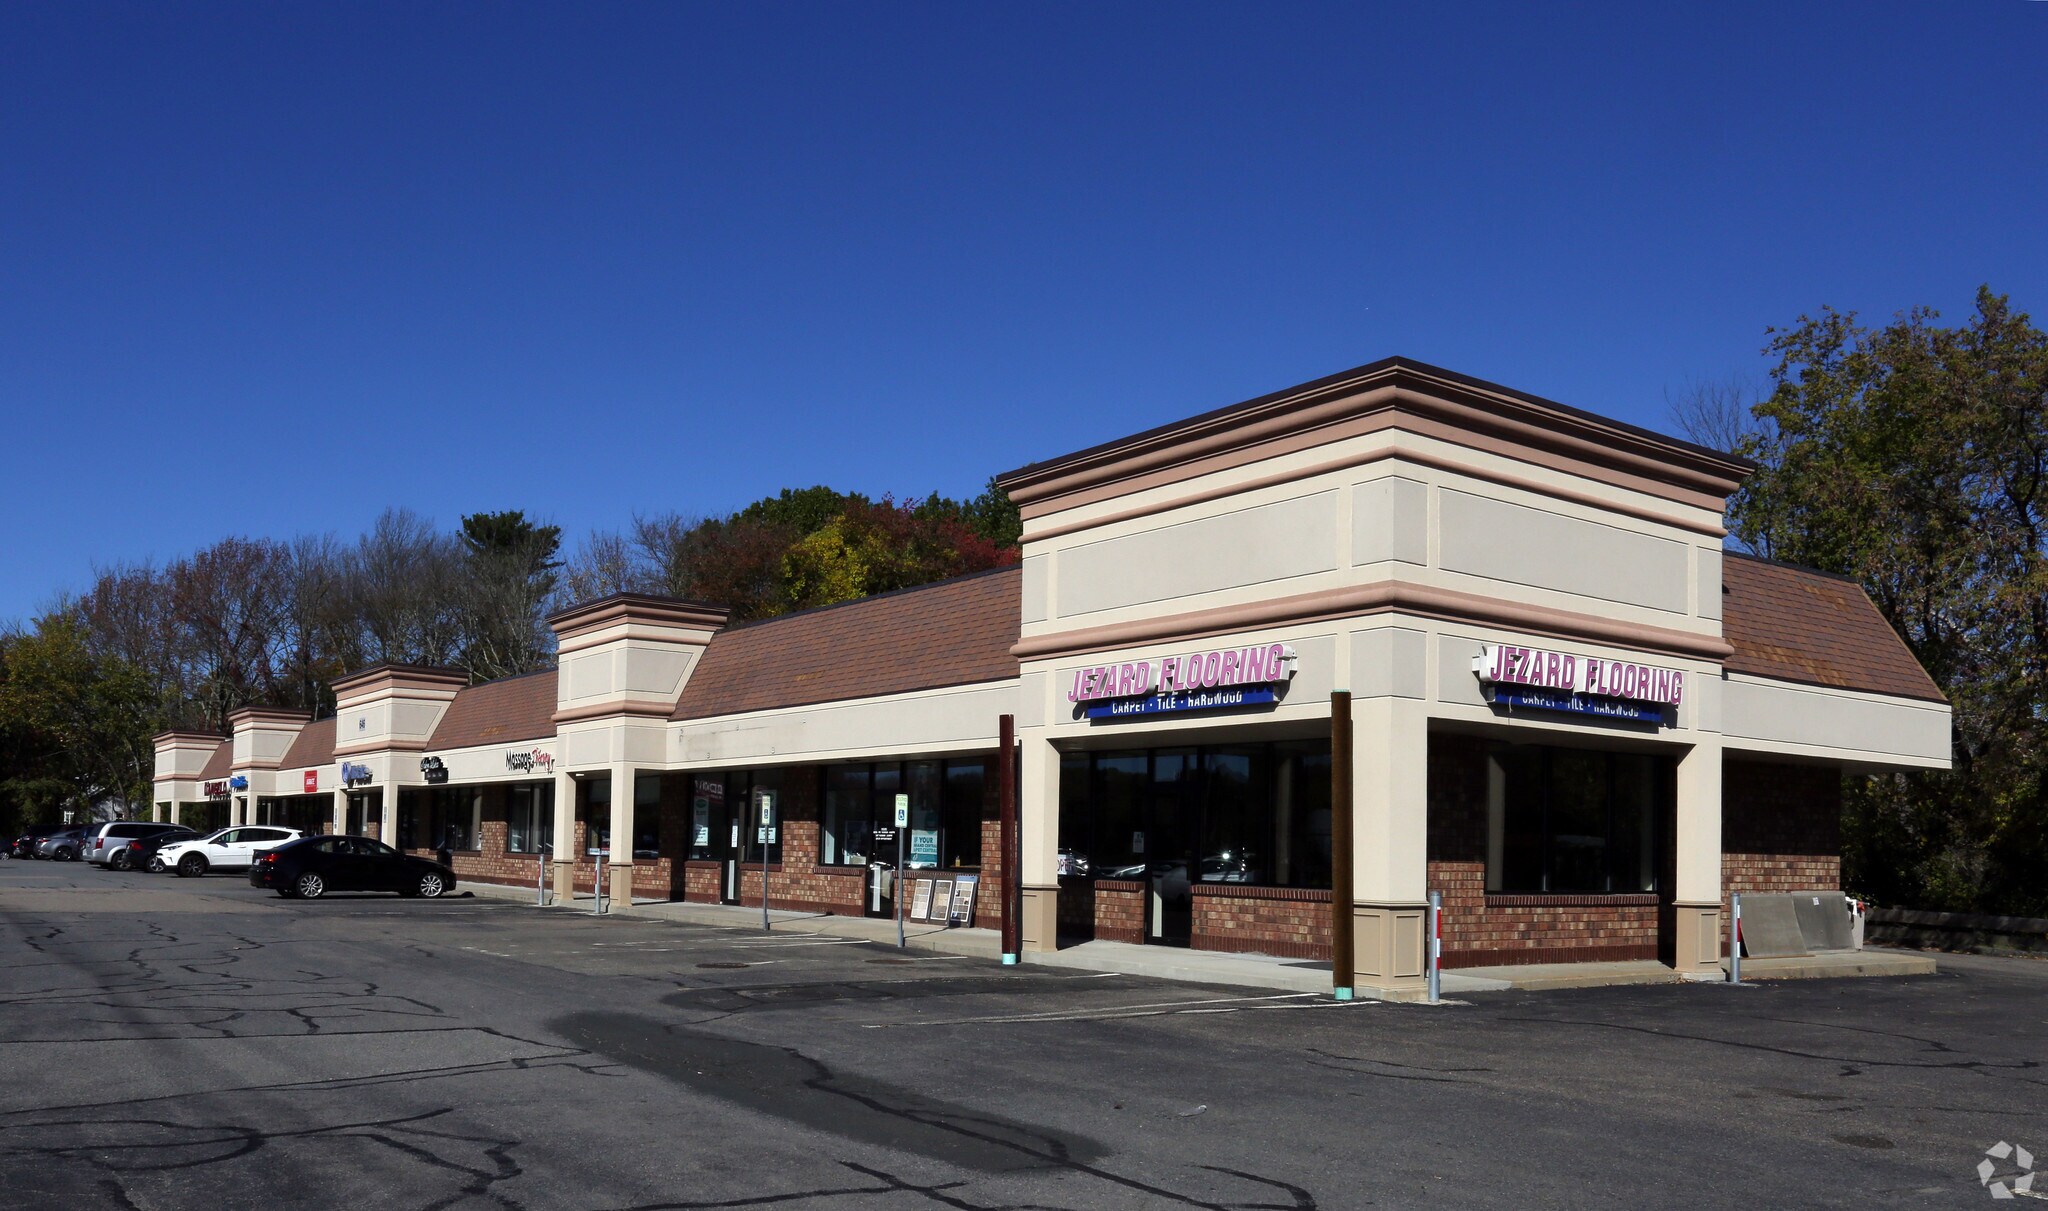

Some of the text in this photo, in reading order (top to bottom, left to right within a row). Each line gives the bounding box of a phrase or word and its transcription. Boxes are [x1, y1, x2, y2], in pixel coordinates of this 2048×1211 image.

[1068, 643, 1285, 703] JEZARD FLOORING
[1112, 690, 1242, 714] CARPET TILE HARDWOOD
[1490, 645, 1684, 705] JEZARD FLOORING
